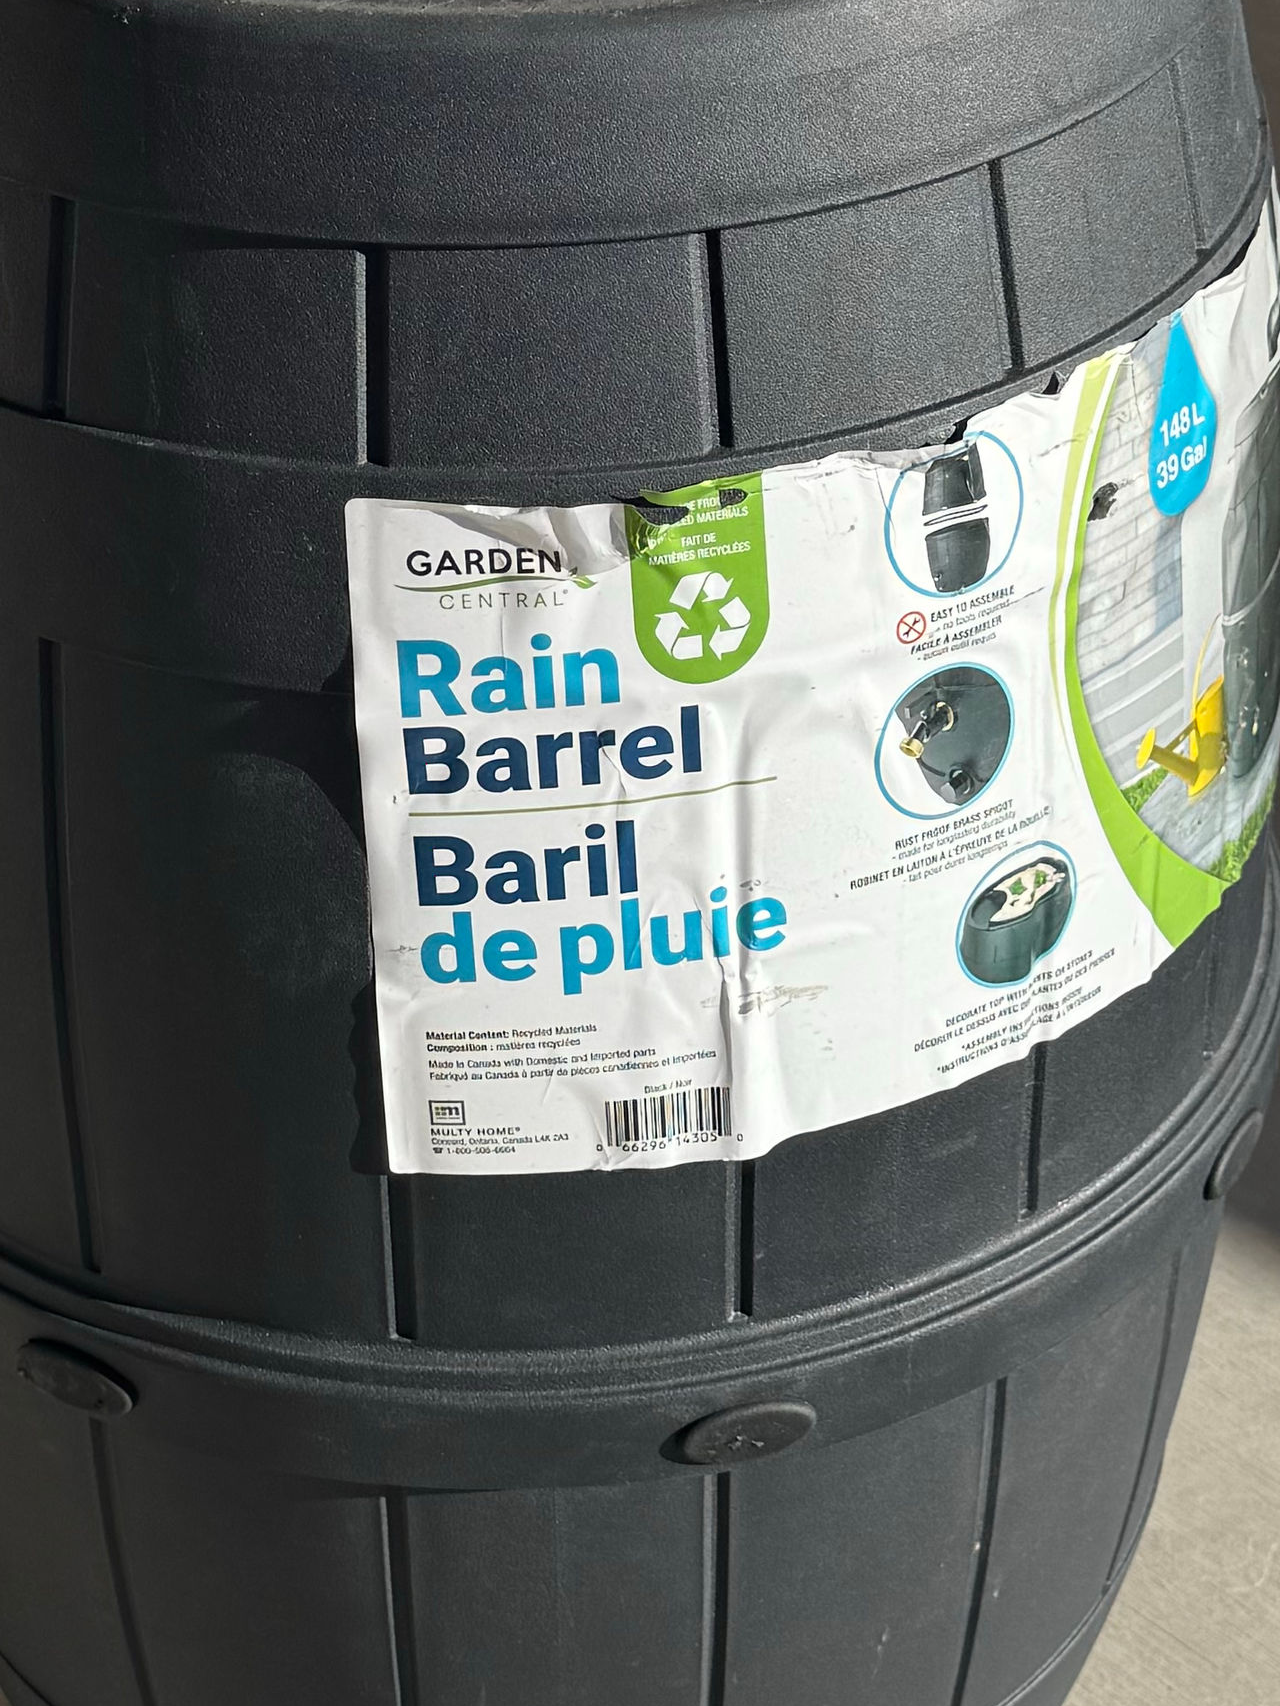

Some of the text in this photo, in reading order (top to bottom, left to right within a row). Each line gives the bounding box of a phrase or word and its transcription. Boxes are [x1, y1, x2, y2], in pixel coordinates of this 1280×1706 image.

[1159, 402, 1205, 447] 148 L
[1156, 435, 1207, 489] 39 Gal
[696, 506, 749, 524] MATERIALS
[681, 534, 701, 548] FAIT
[703, 533, 716, 544] DE
[697, 540, 751, 559] RECYCLÉES
[406, 547, 562, 577] GARDEN
[930, 607, 953, 623] EASY
[970, 585, 1015, 610] ASSEMBLE
[951, 614, 1002, 643] ASSEMBLER
[396, 633, 620, 719] Rain
[402, 704, 703, 795] Barrel
[895, 834, 919, 850] RUST
[953, 812, 981, 831] BRASS
[413, 819, 639, 907] Baril
[850, 870, 890, 891] ROBINET
[892, 865, 904, 878] EN
[995, 828, 1005, 841] DE
[1008, 823, 1018, 835] LA
[420, 885, 788, 996] de pluie
[426, 1024, 597, 1040] Material Content: Recycled Materials
[427, 1042, 488, 1053] Composition
[428, 1059, 454, 1069] Made
[467, 1059, 501, 1069] Canada
[526, 1056, 568, 1066] Domestic
[485, 1070, 520, 1081] Canada
[430, 1128, 472, 1137] MULTY
[596, 1132, 744, 1153] 0 66296 14305 0
